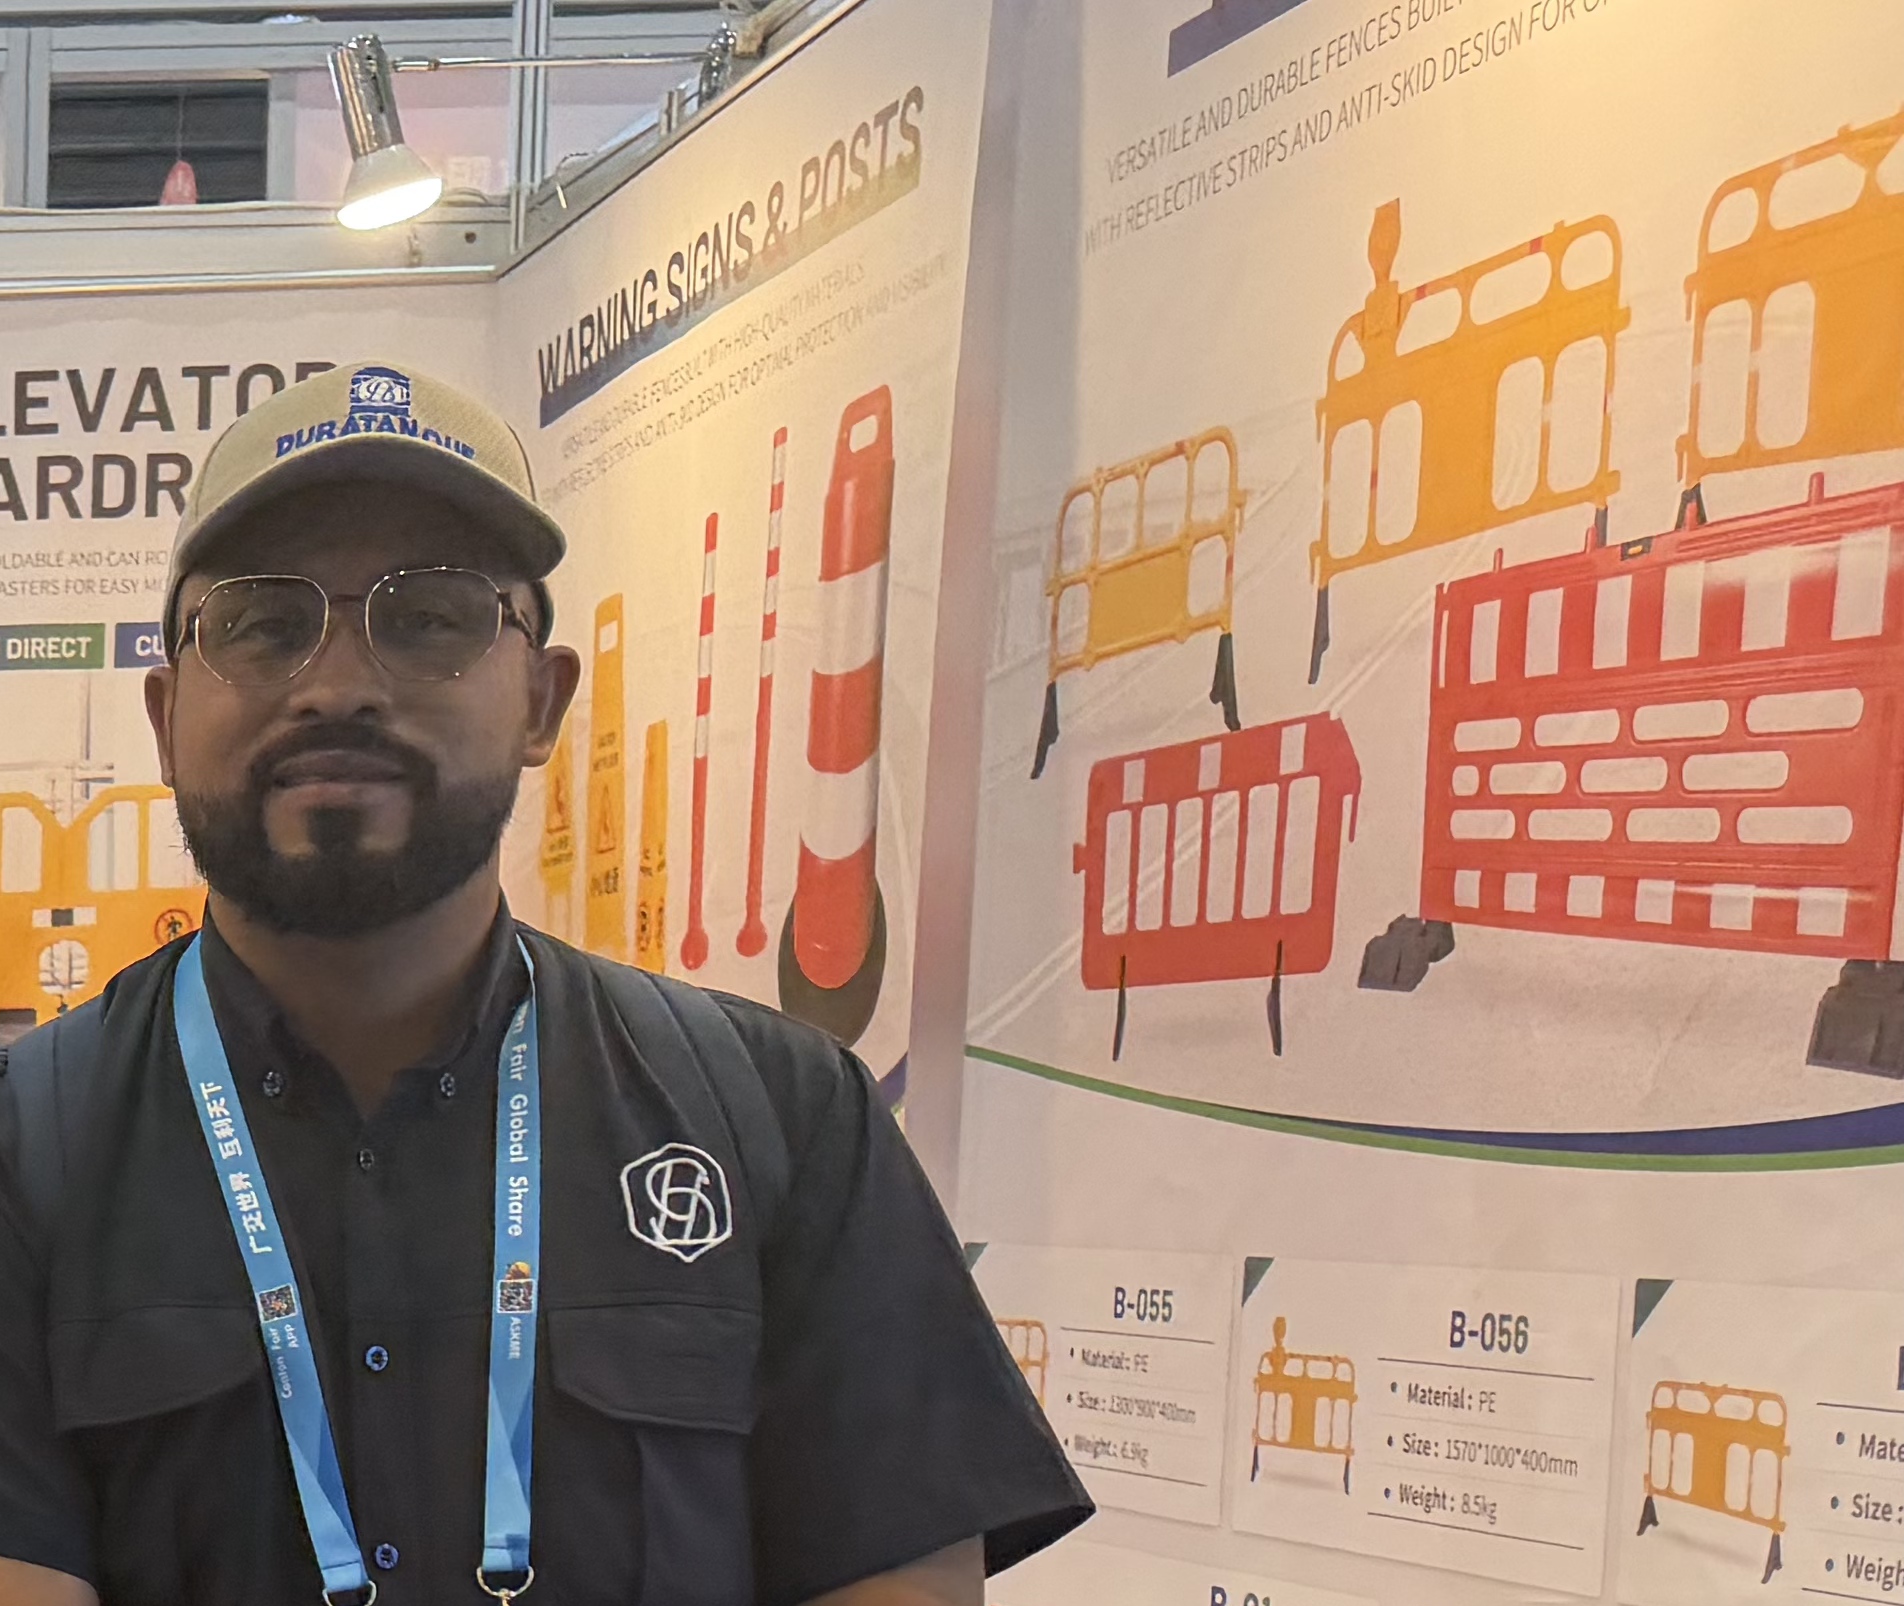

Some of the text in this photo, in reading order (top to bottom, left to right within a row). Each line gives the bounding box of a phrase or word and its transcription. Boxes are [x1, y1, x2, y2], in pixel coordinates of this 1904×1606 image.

[1106, 4, 1402, 184] VERSATILE AND DURABLE FENCES
[1085, 0, 1576, 256] WITH REFLECTIVE STRIPS AND ANTI-SKID DESIGN FOR
[538, 268, 659, 396] WARNING
[666, 201, 756, 317] SIGNS
[763, 180, 788, 260] &
[795, 86, 924, 249] POSTS
[69, 551, 103, 568] AND
[105, 551, 141, 567] CAN
[64, 579, 96, 595] FOR
[100, 578, 140, 595] EASY
[6, 636, 93, 660] DIRECT
[509, 1042, 528, 1081] Fair
[508, 1093, 529, 1164] Global
[198, 1081, 273, 1255] 广交世界 互利天下
[507, 1175, 529, 1237] Share
[1113, 1286, 1174, 1323] B-055
[285, 1323, 300, 1349] APP
[1449, 1310, 1530, 1354] B-056
[1479, 1390, 1497, 1413] PE
[1461, 1493, 1498, 1526] 8.5kg
